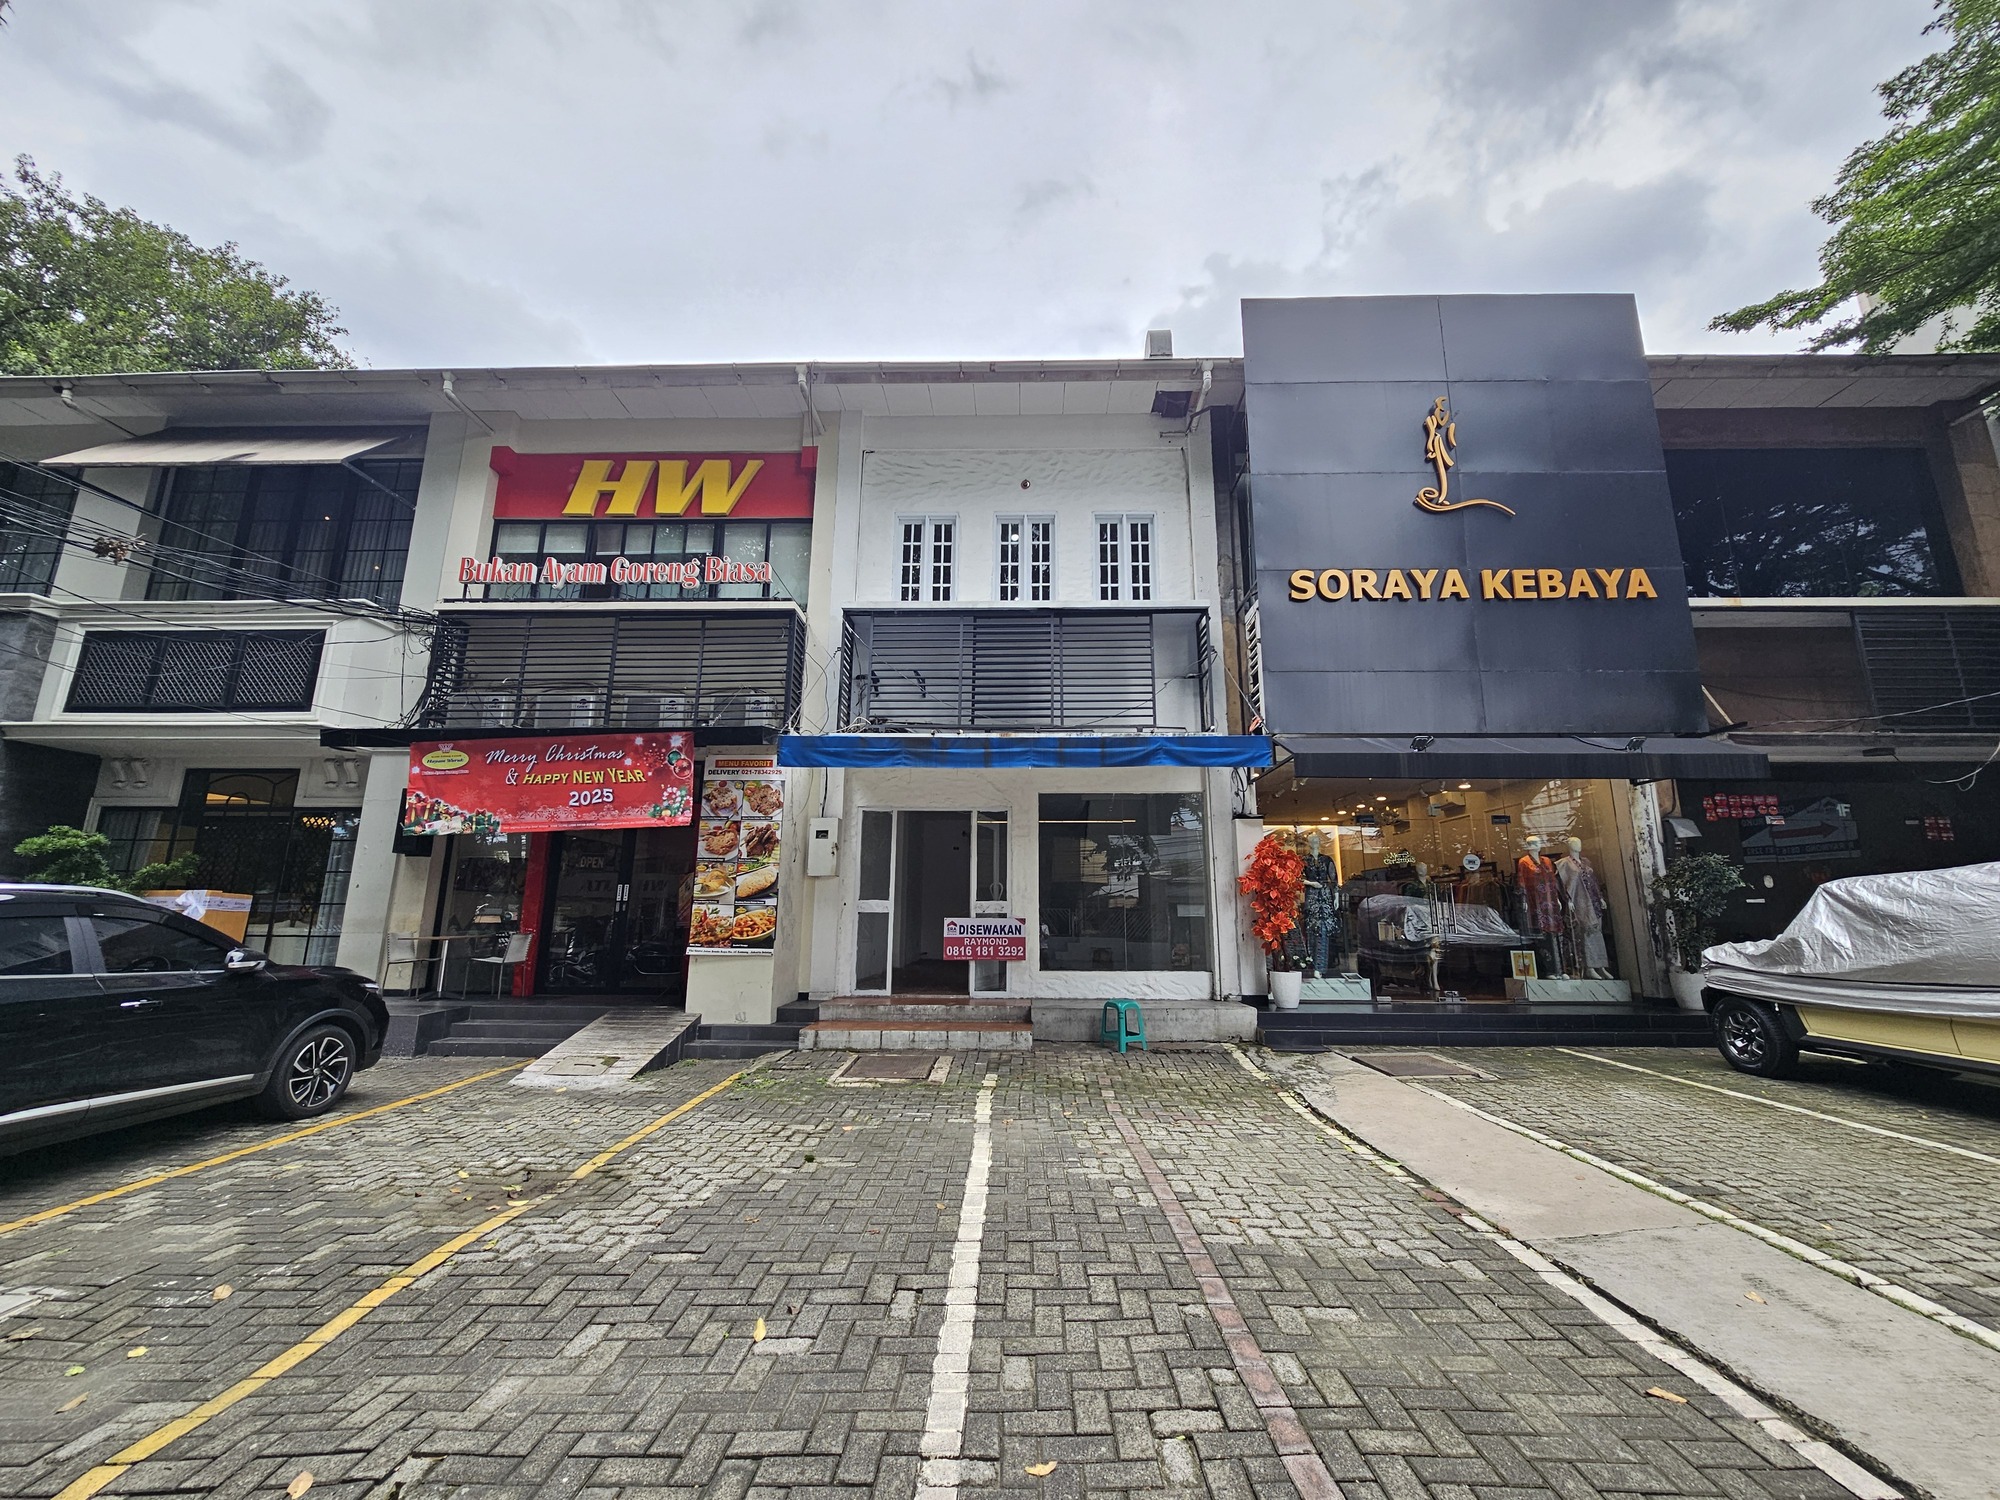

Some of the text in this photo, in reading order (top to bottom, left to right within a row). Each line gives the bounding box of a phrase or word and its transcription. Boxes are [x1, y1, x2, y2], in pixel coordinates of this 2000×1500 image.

[562, 459, 765, 517] HW
[459, 556, 773, 590] Bukan Ayam Goreng Biasa
[1290, 568, 1658, 600] SORAYA KEBAYA
[485, 744, 625, 773] Merry Christmas
[505, 767, 646, 785] & HAPPY NEW YEAR
[569, 788, 614, 807] 2025
[580, 856, 605, 868] OPEN
[958, 924, 1022, 936] DISEWAKAN
[946, 946, 1024, 956] 0816 181 3292
[964, 938, 1009, 946] RAYMOND
